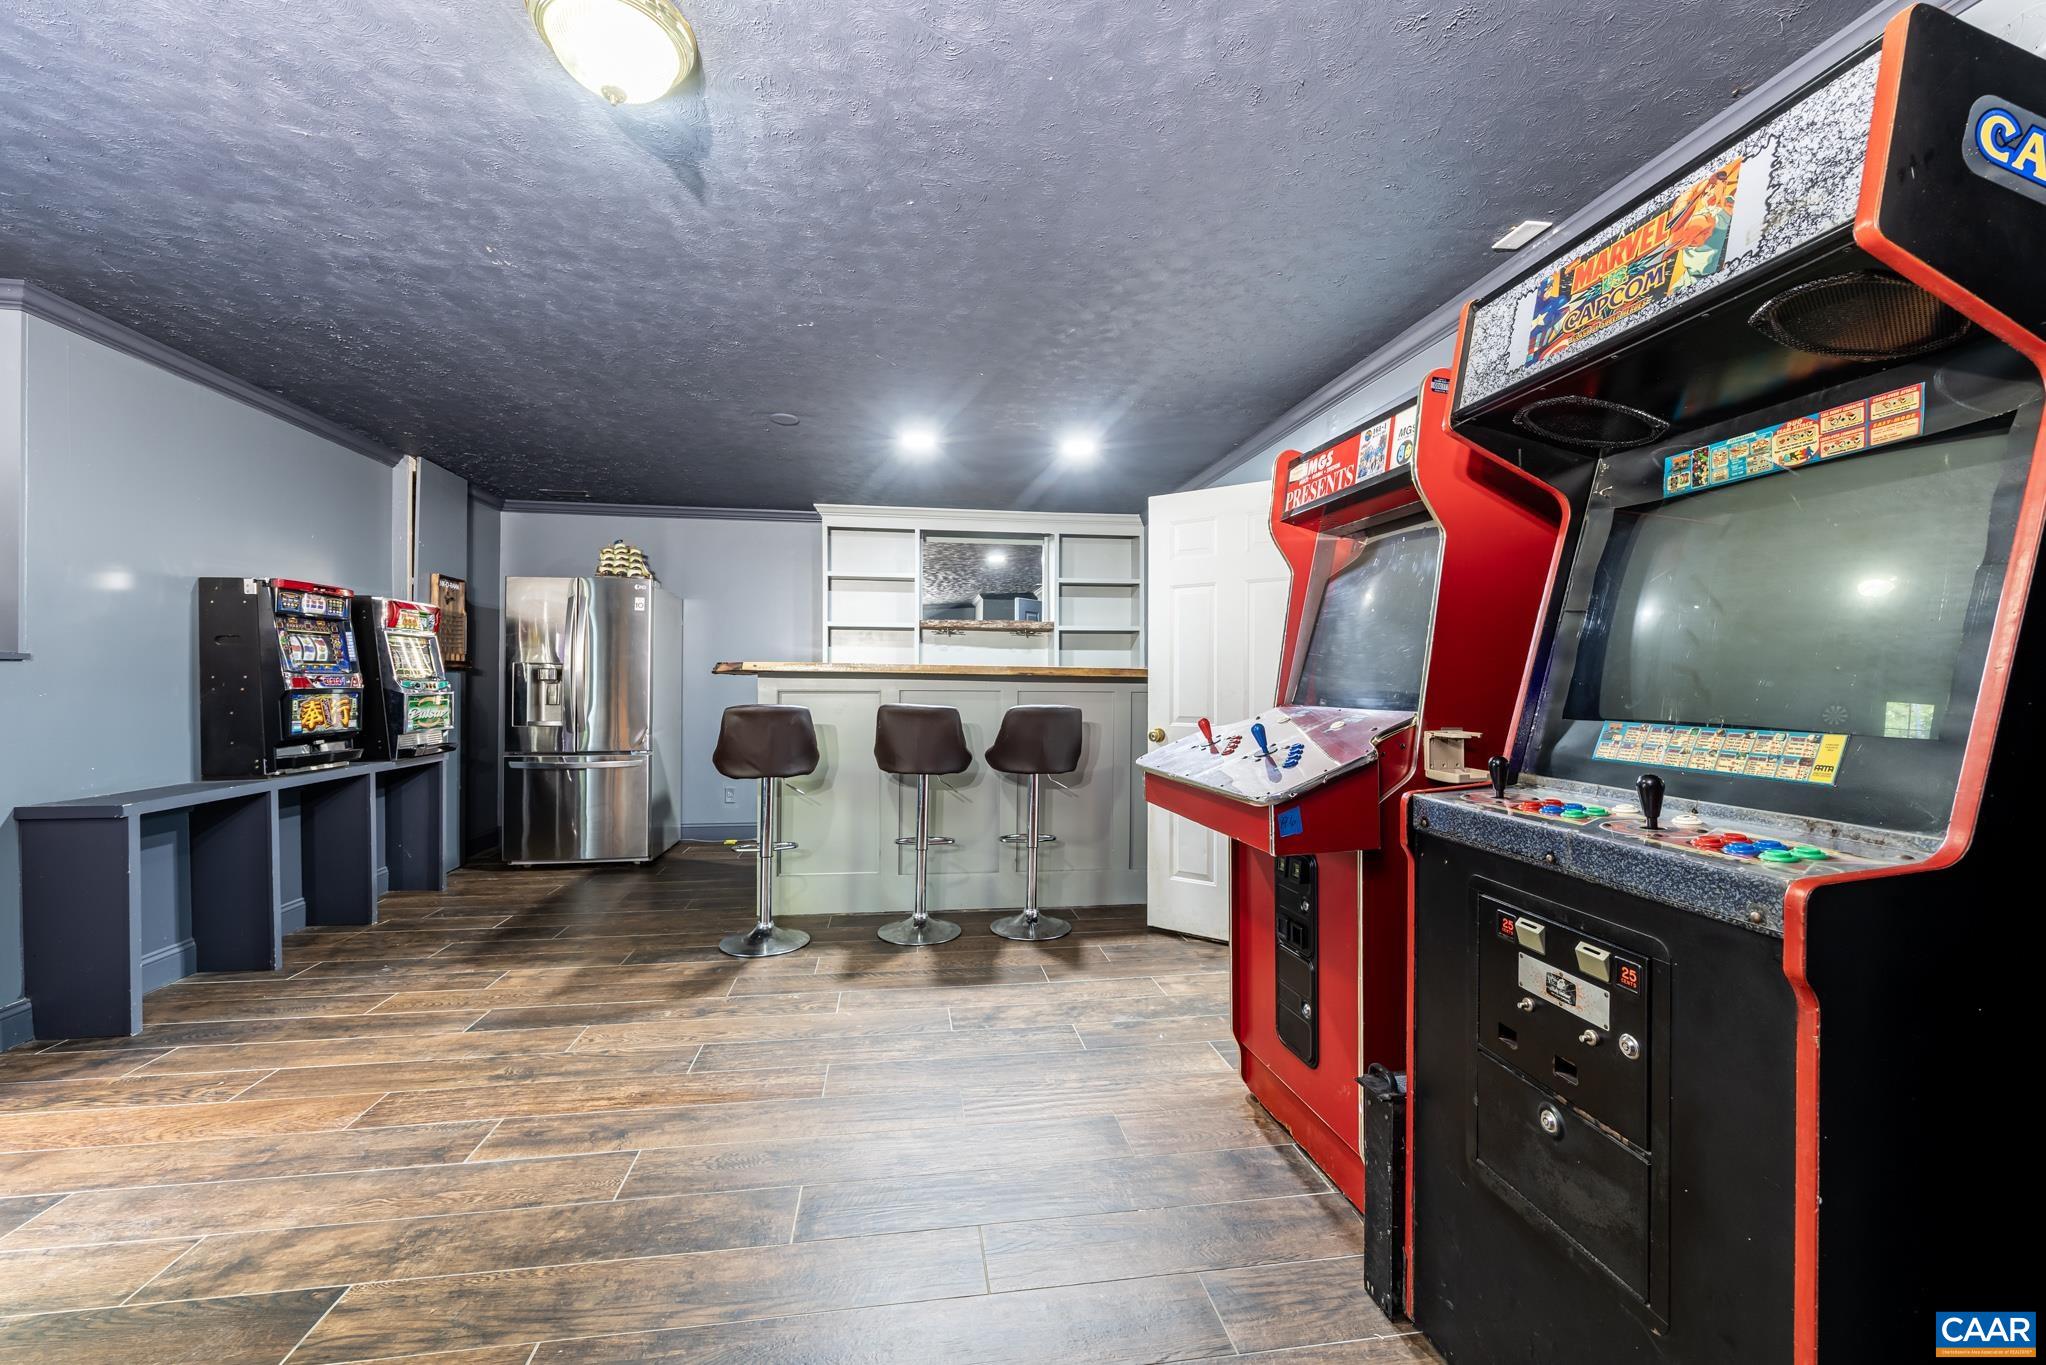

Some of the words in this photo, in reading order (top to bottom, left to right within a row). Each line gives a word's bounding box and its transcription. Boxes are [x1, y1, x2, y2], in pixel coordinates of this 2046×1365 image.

[1571, 210, 1670, 295] MARVEL
[1562, 262, 1666, 333] CAPCOM
[1308, 450, 1334, 475] MGS
[1285, 464, 1355, 512] PRESENTS
[1503, 918, 1514, 931] 25
[1621, 966, 1637, 982] 25
[1621, 978, 1637, 989] CENTS
